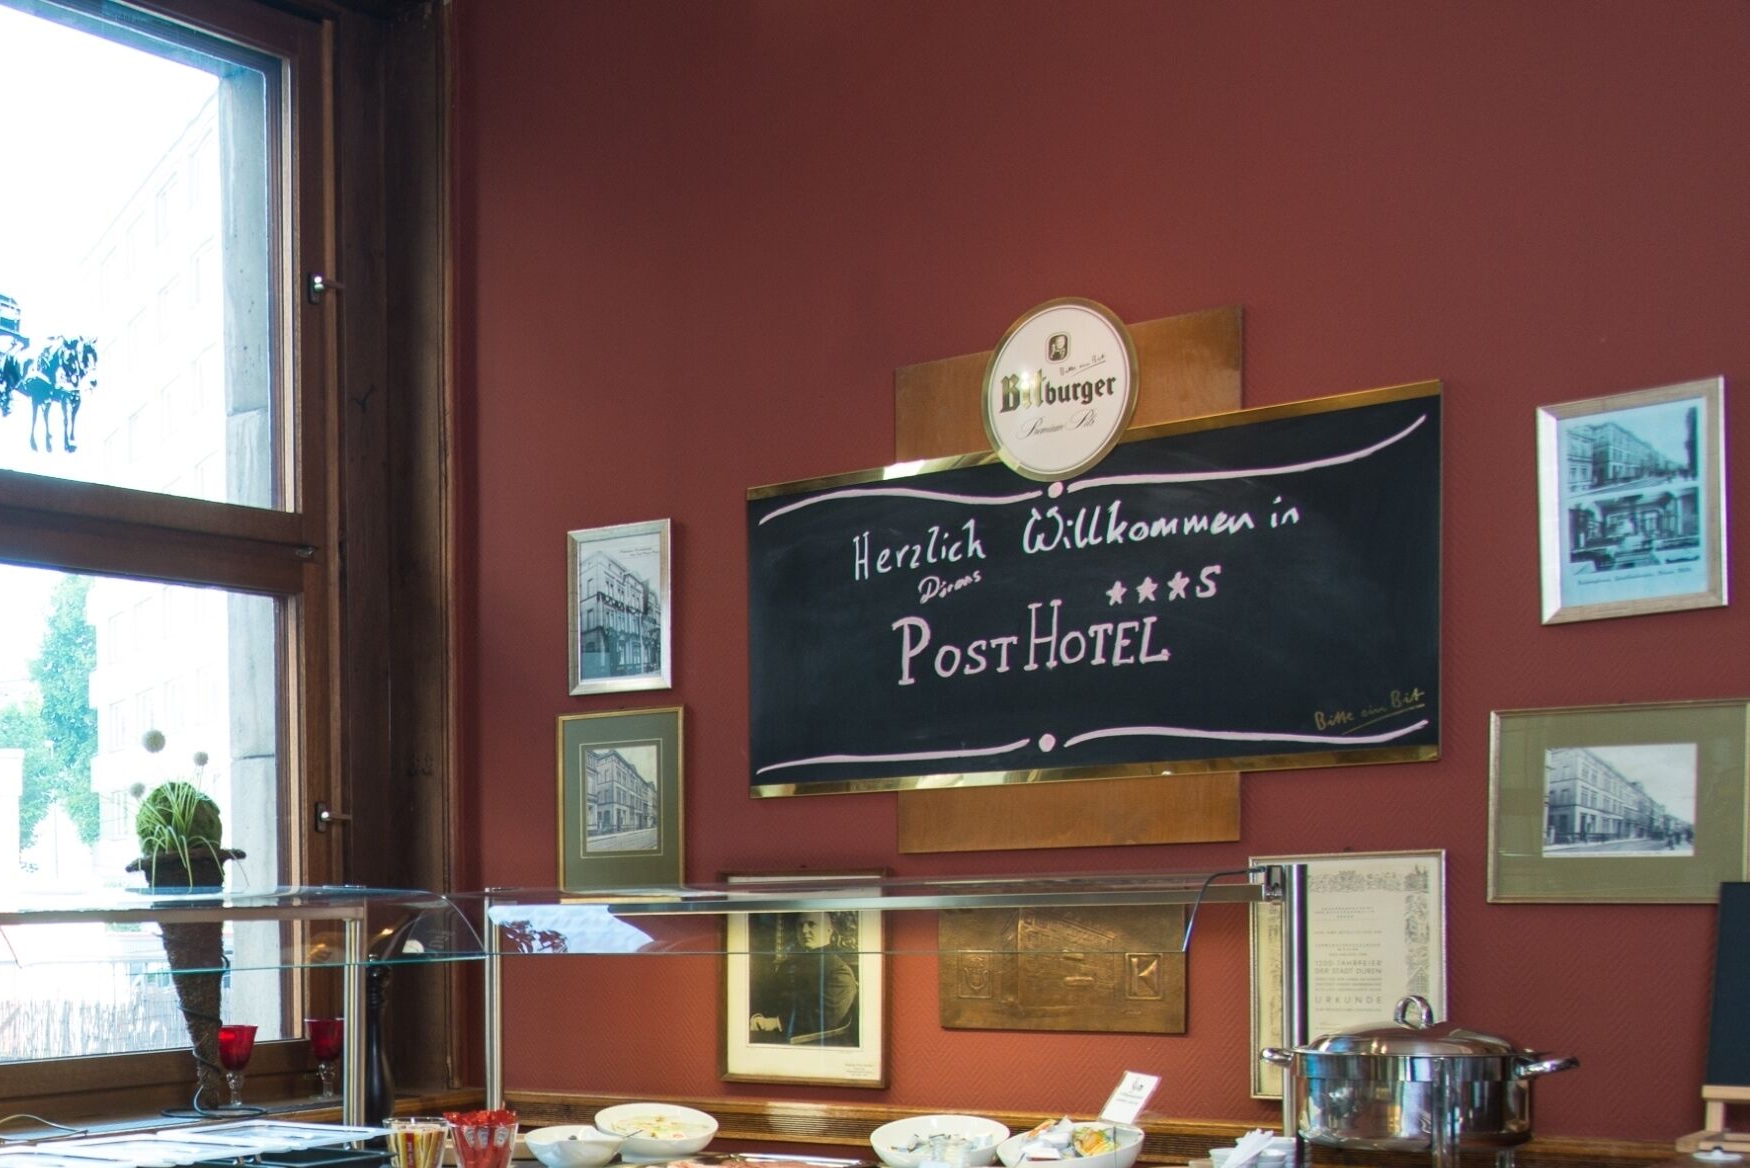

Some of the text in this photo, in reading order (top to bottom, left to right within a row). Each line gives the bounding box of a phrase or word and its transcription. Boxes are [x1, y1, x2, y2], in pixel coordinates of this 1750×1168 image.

[853, 496, 1300, 581] Herzlich Willkommen in
